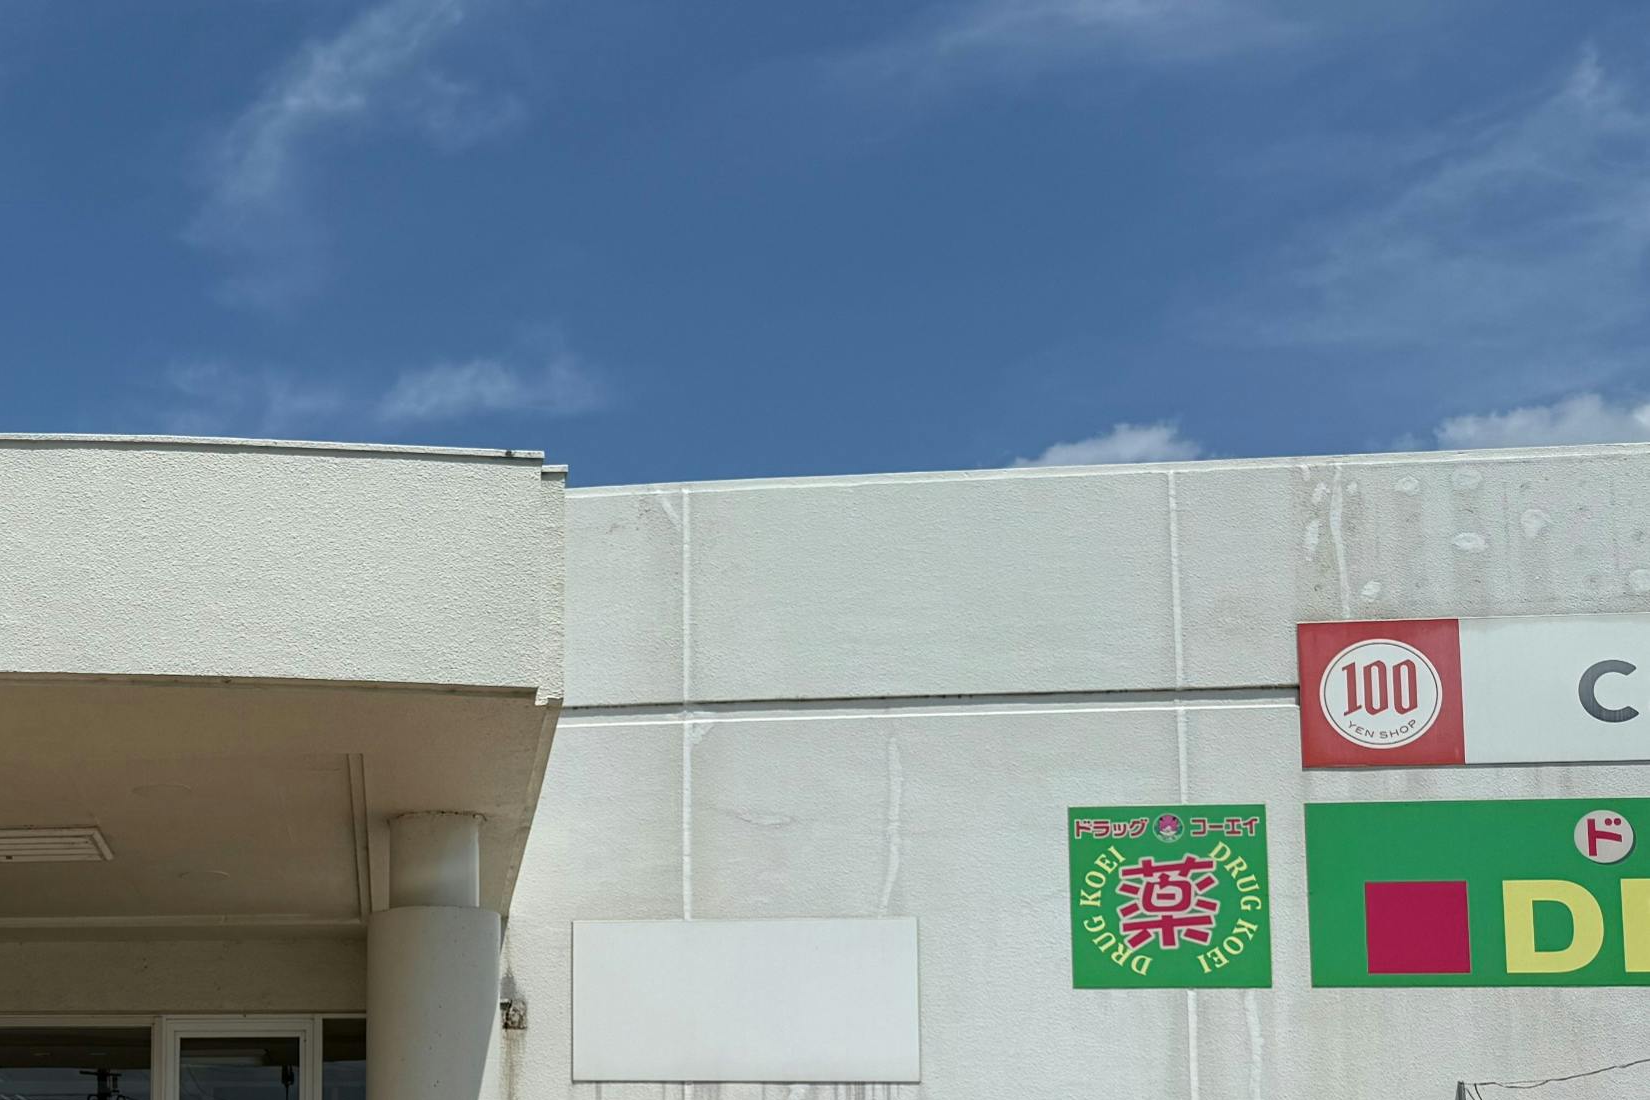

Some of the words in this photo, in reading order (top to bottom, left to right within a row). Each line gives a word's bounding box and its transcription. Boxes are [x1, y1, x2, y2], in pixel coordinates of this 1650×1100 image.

[1342, 659, 1418, 717] 100
[1348, 720, 1374, 737] YEN
[1379, 719, 1417, 738] SHOP
[1075, 819, 1148, 837] ドラッグ
[1191, 818, 1258, 836] コーエイ
[1587, 818, 1622, 856] ド
[1080, 846, 1126, 907] KOEI
[1116, 854, 1220, 949] 薬
[1209, 841, 1261, 911] DRUG
[1084, 915, 1153, 976] DRUG
[1197, 919, 1258, 974] KOEI
